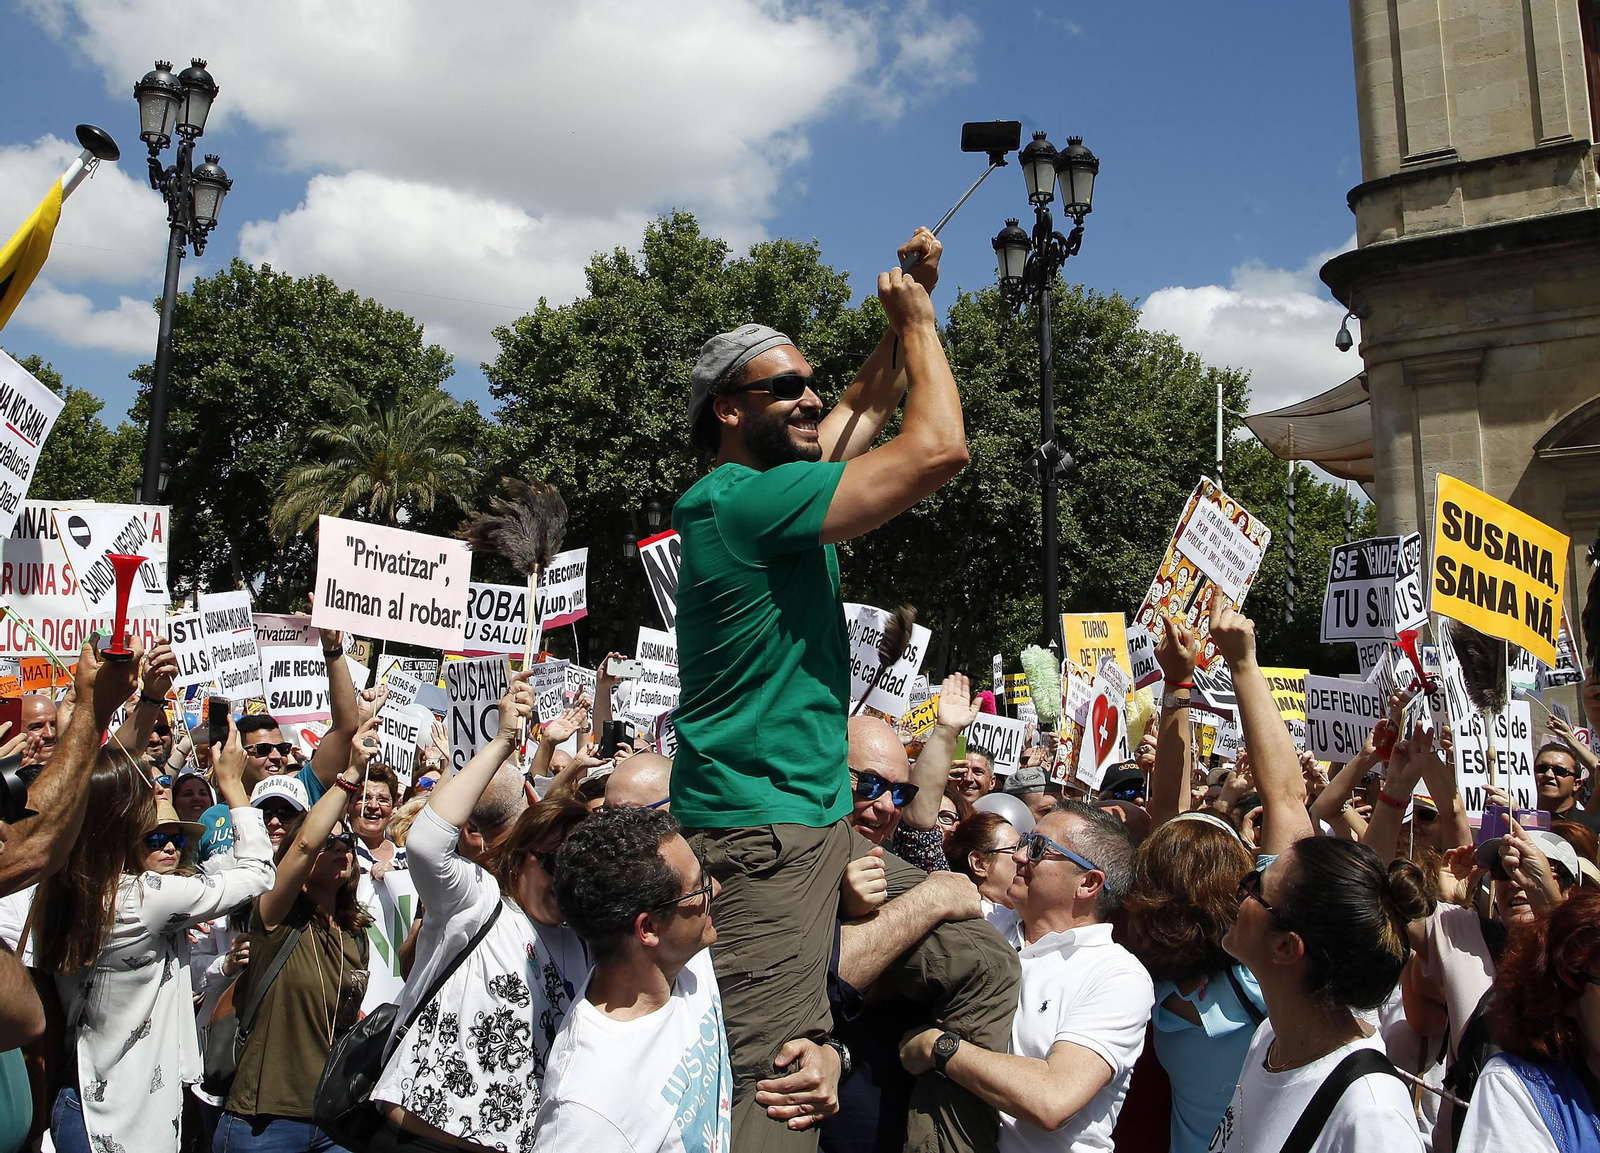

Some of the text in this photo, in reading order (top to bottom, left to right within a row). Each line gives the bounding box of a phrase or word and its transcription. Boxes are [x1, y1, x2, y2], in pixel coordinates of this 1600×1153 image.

[7, 393, 26, 426] NO
[1207, 510, 1233, 543] GRANADA
[1184, 528, 1207, 556] PUBLICA
[1195, 520, 1246, 572] POR UNA SANIDAD
[1442, 500, 1559, 595] SUSANA,
[346, 535, 450, 588] "Privatizar",
[1333, 549, 1359, 579] SE
[18, 563, 57, 596] UNA
[80, 549, 115, 605] SANIDA
[324, 578, 463, 630] llaman al robar.
[467, 587, 546, 626] ROBAN
[1333, 588, 1359, 628] TU
[1435, 555, 1519, 621] SANA
[1525, 590, 1557, 648] NÁ.
[204, 610, 230, 635] SUSANA
[228, 608, 237, 631] NO
[1082, 620, 1109, 639] TURNO
[182, 650, 210, 677] LA S
[211, 638, 256, 669] ¡Pobre Andalucía
[403, 661, 437, 671] SE VENDE
[640, 641, 665, 661] SUSANA
[1080, 648, 1091, 667] DE
[221, 667, 242, 692] España
[268, 660, 290, 682] ¡ME
[388, 674, 417, 695] LISTAS de
[449, 660, 509, 703] SUSANA
[861, 663, 908, 697] caldad.
[270, 689, 313, 709] SALUD
[316, 692, 323, 710] y
[387, 689, 411, 707] SPERA
[640, 688, 661, 707] España
[1307, 688, 1380, 720] ¡DEFIENDE
[1308, 720, 1328, 752] TU
[1511, 715, 1528, 740] de
[258, 776, 299, 798] GRANADA
[675, 1103, 698, 1130] por
